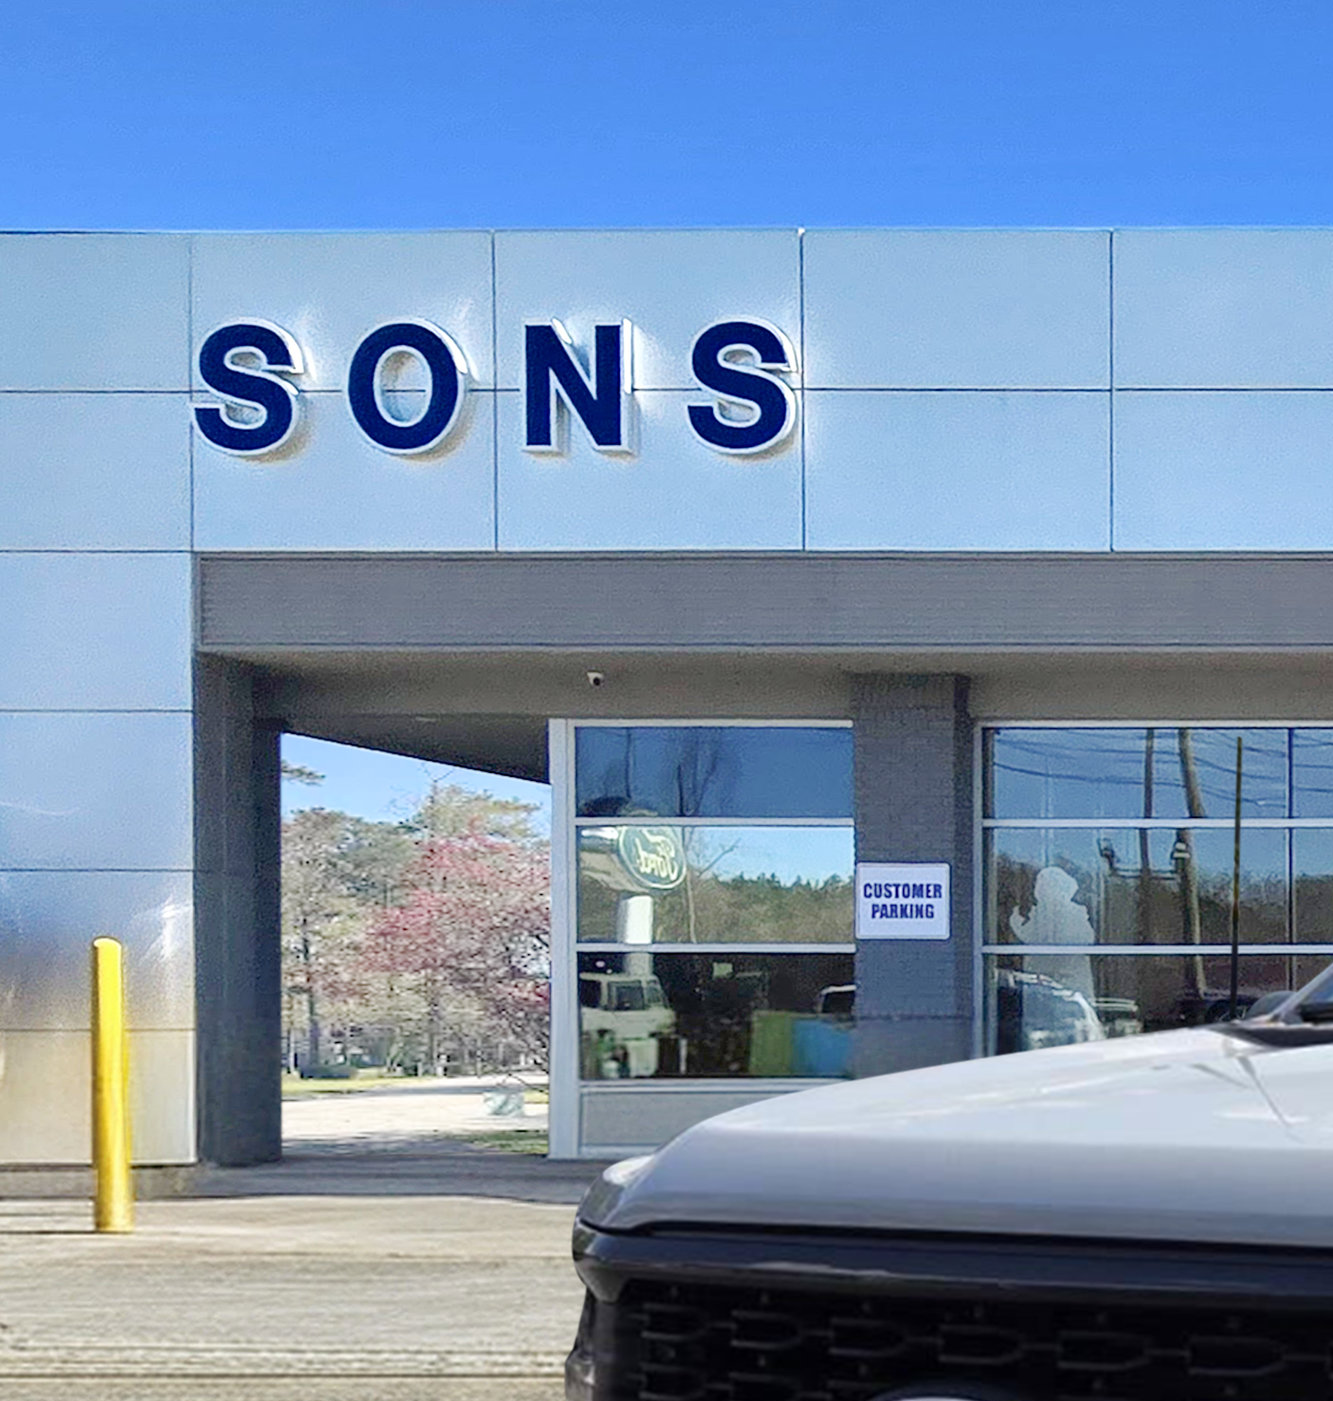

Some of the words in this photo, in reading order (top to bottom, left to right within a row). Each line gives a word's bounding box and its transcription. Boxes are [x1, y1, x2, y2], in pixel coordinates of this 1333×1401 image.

[193, 320, 796, 452] SONS
[863, 882, 943, 899] CUSTOMER
[871, 903, 935, 919] PARKING
